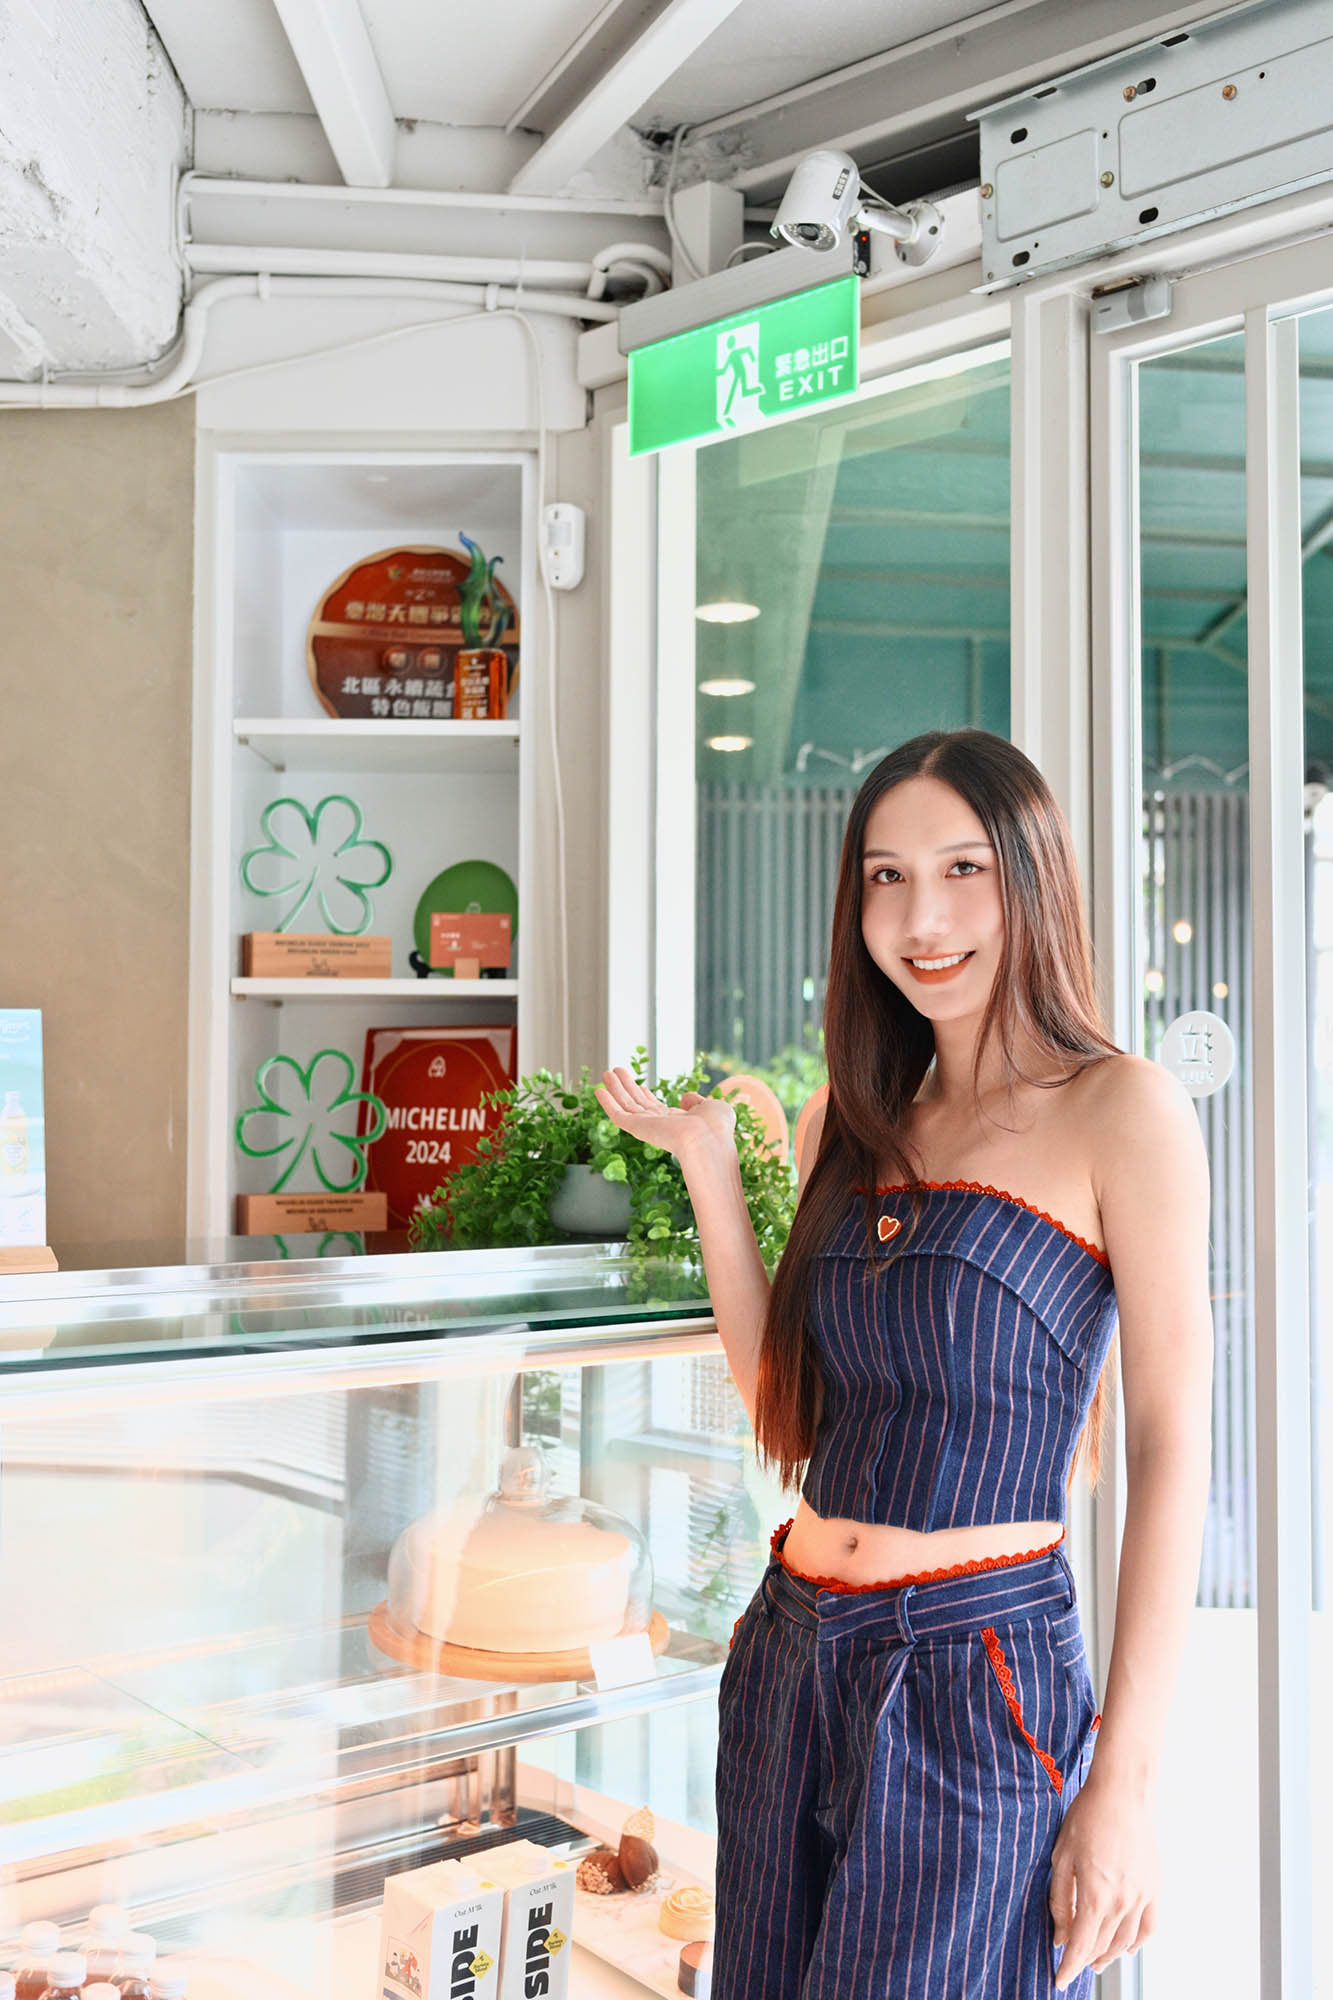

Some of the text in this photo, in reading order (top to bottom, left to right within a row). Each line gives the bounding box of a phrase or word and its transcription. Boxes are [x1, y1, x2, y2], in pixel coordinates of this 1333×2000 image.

[775, 335, 849, 378] 緊急出口
[779, 365, 844, 402] EXIT
[386, 1106, 486, 1132] MICHELIN
[405, 1140, 452, 1164] 2024
[450, 1924, 479, 2000] IDE
[524, 1902, 553, 1999] SIDE
